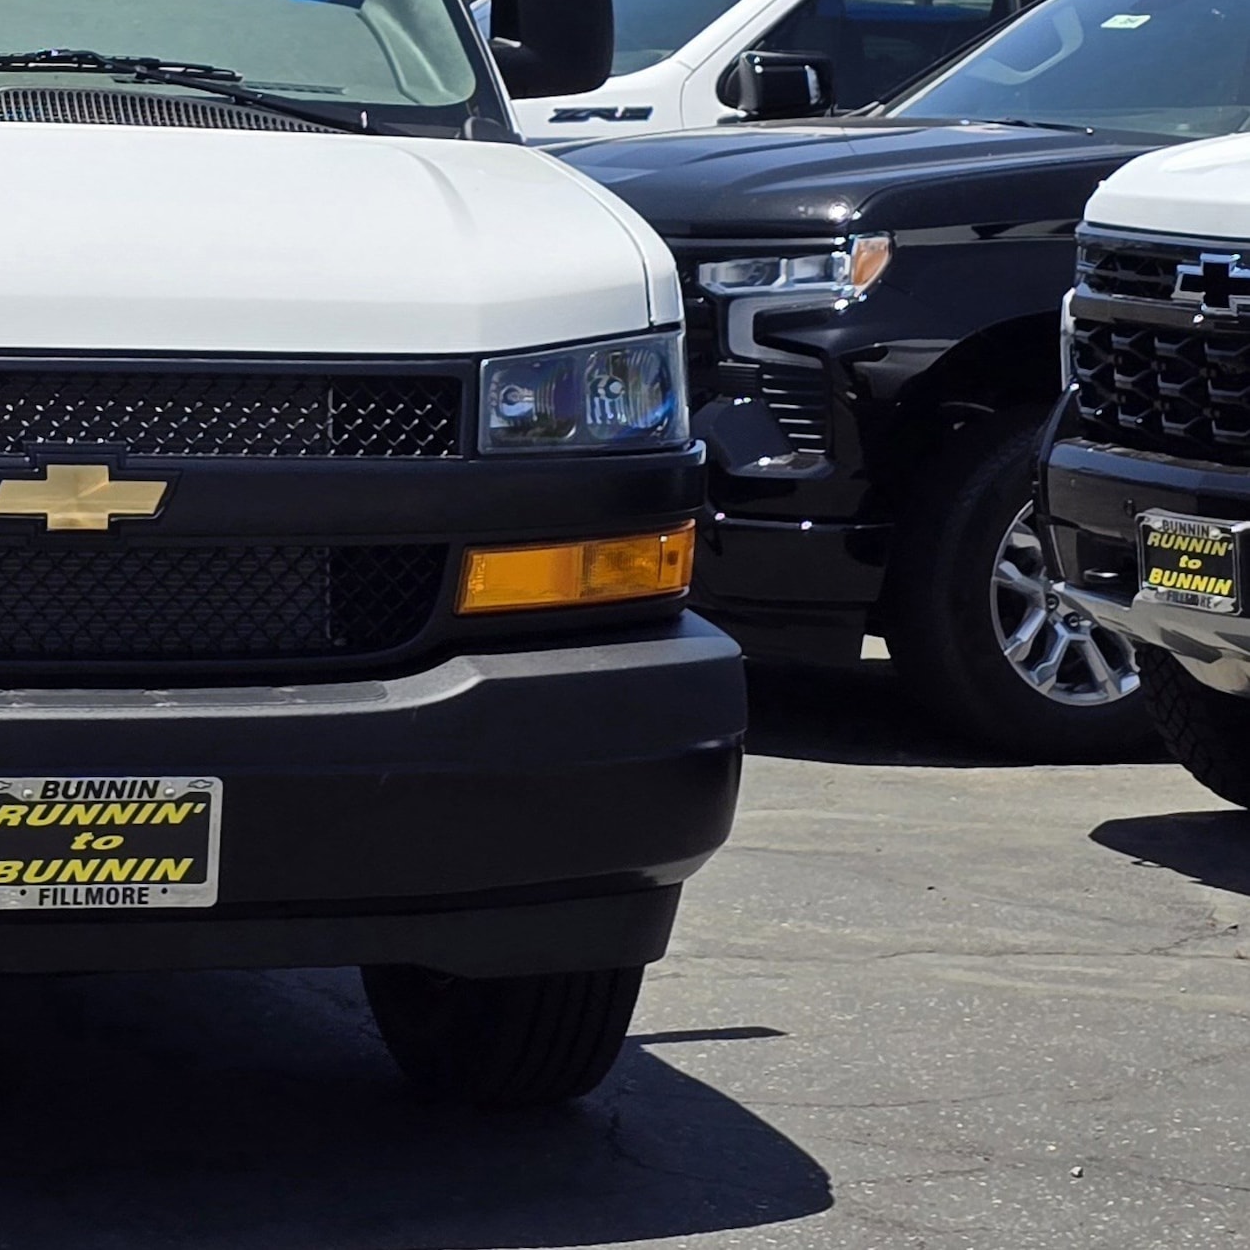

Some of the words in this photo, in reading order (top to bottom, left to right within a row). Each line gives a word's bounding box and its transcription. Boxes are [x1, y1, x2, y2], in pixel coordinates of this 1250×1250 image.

[1162, 520, 1210, 537] BUNNIN
[1147, 531, 1234, 557] RUNNIN'
[1179, 555, 1202, 569] to
[1148, 567, 1233, 596] BUNNIN
[40, 780, 160, 800] BUNNIN
[70, 831, 125, 850] to
[38, 887, 150, 906] FILLMORE
